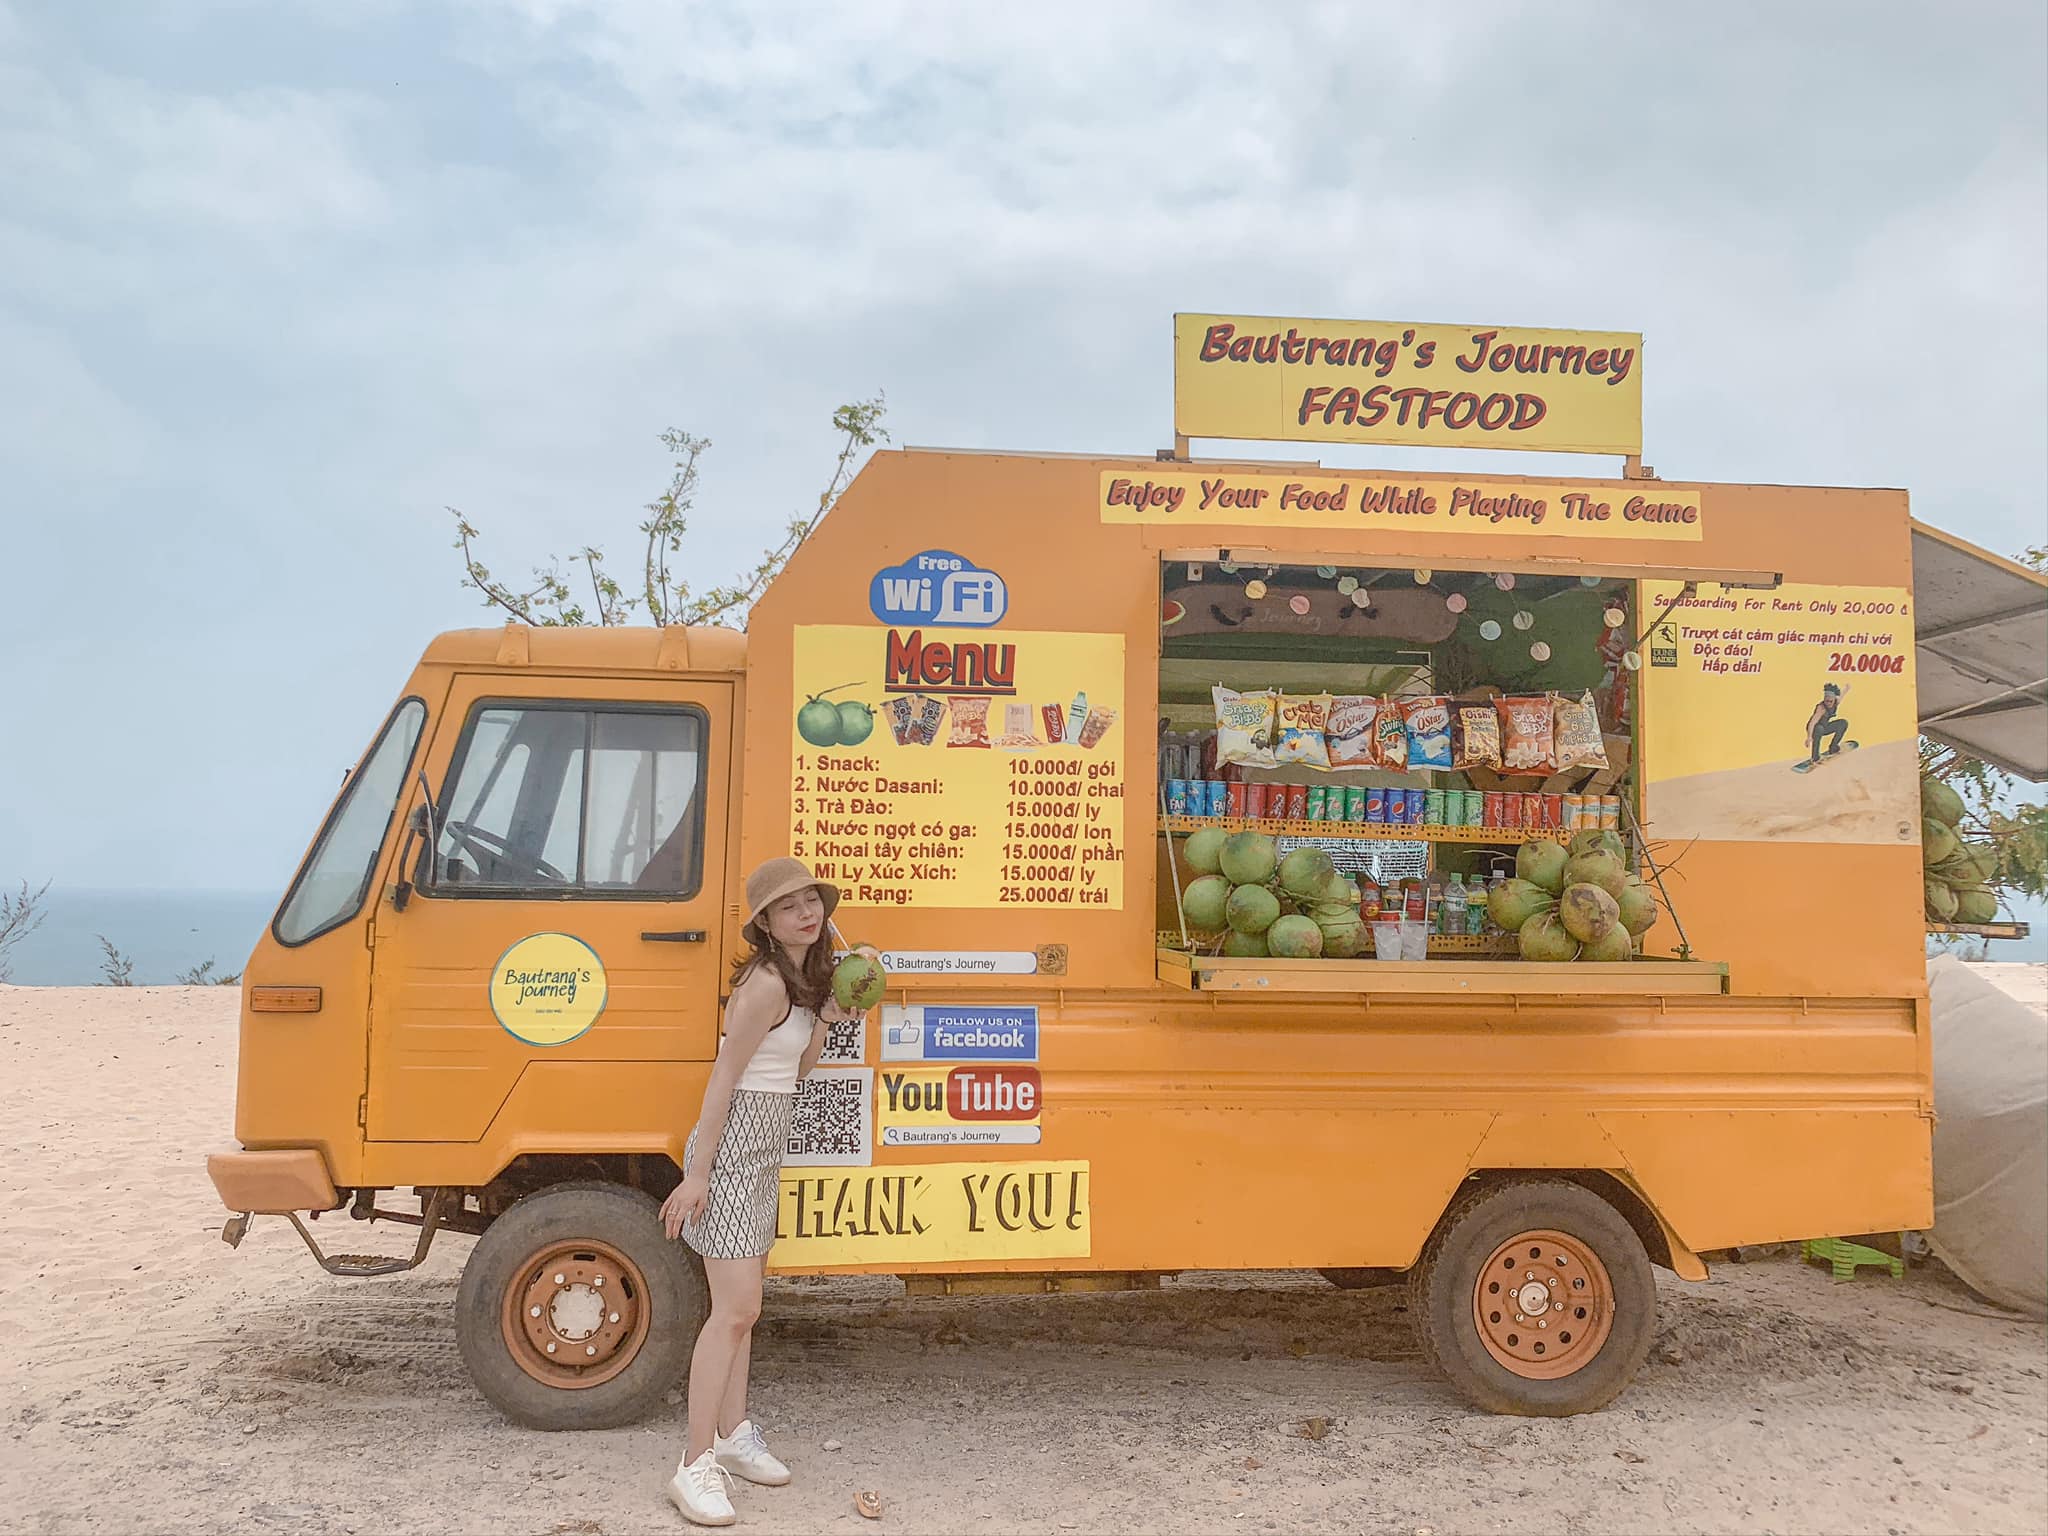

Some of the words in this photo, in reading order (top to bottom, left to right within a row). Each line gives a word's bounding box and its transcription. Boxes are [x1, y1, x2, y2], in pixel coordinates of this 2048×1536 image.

[1200, 324, 1435, 376] Bautrang's
[1455, 331, 1634, 385] Journey
[1299, 386, 1546, 430] FASTFOOD
[1107, 479, 1184, 510] Enjoy
[1200, 479, 1268, 508] Your
[1280, 484, 1348, 511] Food
[1361, 485, 1437, 514] While
[1450, 487, 1546, 523] Playing
[1561, 493, 1611, 522] The
[1624, 498, 1698, 523] Game
[919, 556, 962, 570] Free
[1744, 599, 1765, 609] For
[1772, 599, 1802, 610] Rent
[1809, 600, 1837, 615] Only
[1843, 601, 1895, 615] 20,000
[1681, 627, 1719, 641] Trượt
[1722, 628, 1743, 640] cát
[1777, 631, 1804, 644] giác
[1808, 632, 1844, 645] mạnh
[1872, 633, 1893, 645] với
[886, 629, 1016, 687] Menu
[1694, 643, 1720, 657] Độc
[1724, 644, 1753, 656] đáo!
[1702, 658, 1729, 674] Hấp
[1733, 659, 1762, 672] dẫn!
[1829, 653, 1906, 673] 20.000đ
[796, 755, 810, 770] 1.
[817, 755, 880, 771] Snack:
[1009, 759, 1083, 775] 10.000đ/
[1088, 761, 1115, 779] gói
[794, 776, 810, 792] 2.
[817, 776, 869, 793] Nước
[875, 778, 943, 793] Dasani:
[1009, 780, 1082, 796] 10.000đ/
[1087, 782, 1124, 797] chai
[794, 798, 810, 813] 3.
[816, 798, 845, 814] Trà
[850, 798, 893, 814] Đào:
[1006, 801, 1080, 817] 15.000đ/
[1085, 803, 1100, 821] ly
[794, 819, 809, 835] 4.
[816, 819, 868, 836] Nước
[874, 821, 916, 840] ngọt
[921, 821, 943, 837] có
[949, 824, 977, 840] ga:
[1005, 822, 1078, 839] 15.000đ/
[1084, 824, 1111, 839] lon
[794, 841, 808, 857] 5.
[815, 841, 868, 858] Khoai
[875, 842, 902, 861] tây
[908, 842, 963, 858] chiên:
[1002, 843, 1077, 860] 15.000đ/
[815, 863, 836, 879] Mì
[842, 864, 863, 882] Ly
[869, 863, 904, 879] Xúc
[910, 863, 956, 880] Xích:
[1001, 865, 1075, 881] 15.000đ/
[1080, 866, 1095, 885] ly
[859, 885, 913, 904] Rạng:
[999, 887, 1074, 903] 25.000đ/
[1080, 888, 1108, 903] trái
[897, 958, 952, 971] Bautrang's
[955, 958, 996, 972] Journey
[504, 968, 591, 987] Bautrang's
[516, 983, 577, 1005] journey
[938, 1017, 985, 1026] FOLLOW
[988, 1017, 1005, 1026] US
[1007, 1017, 1023, 1027] ON
[933, 1029, 1025, 1048] facebook
[903, 1130, 957, 1142] Bautrang's
[960, 1131, 1000, 1143] Journey
[961, 1171, 1089, 1232] YOU!
